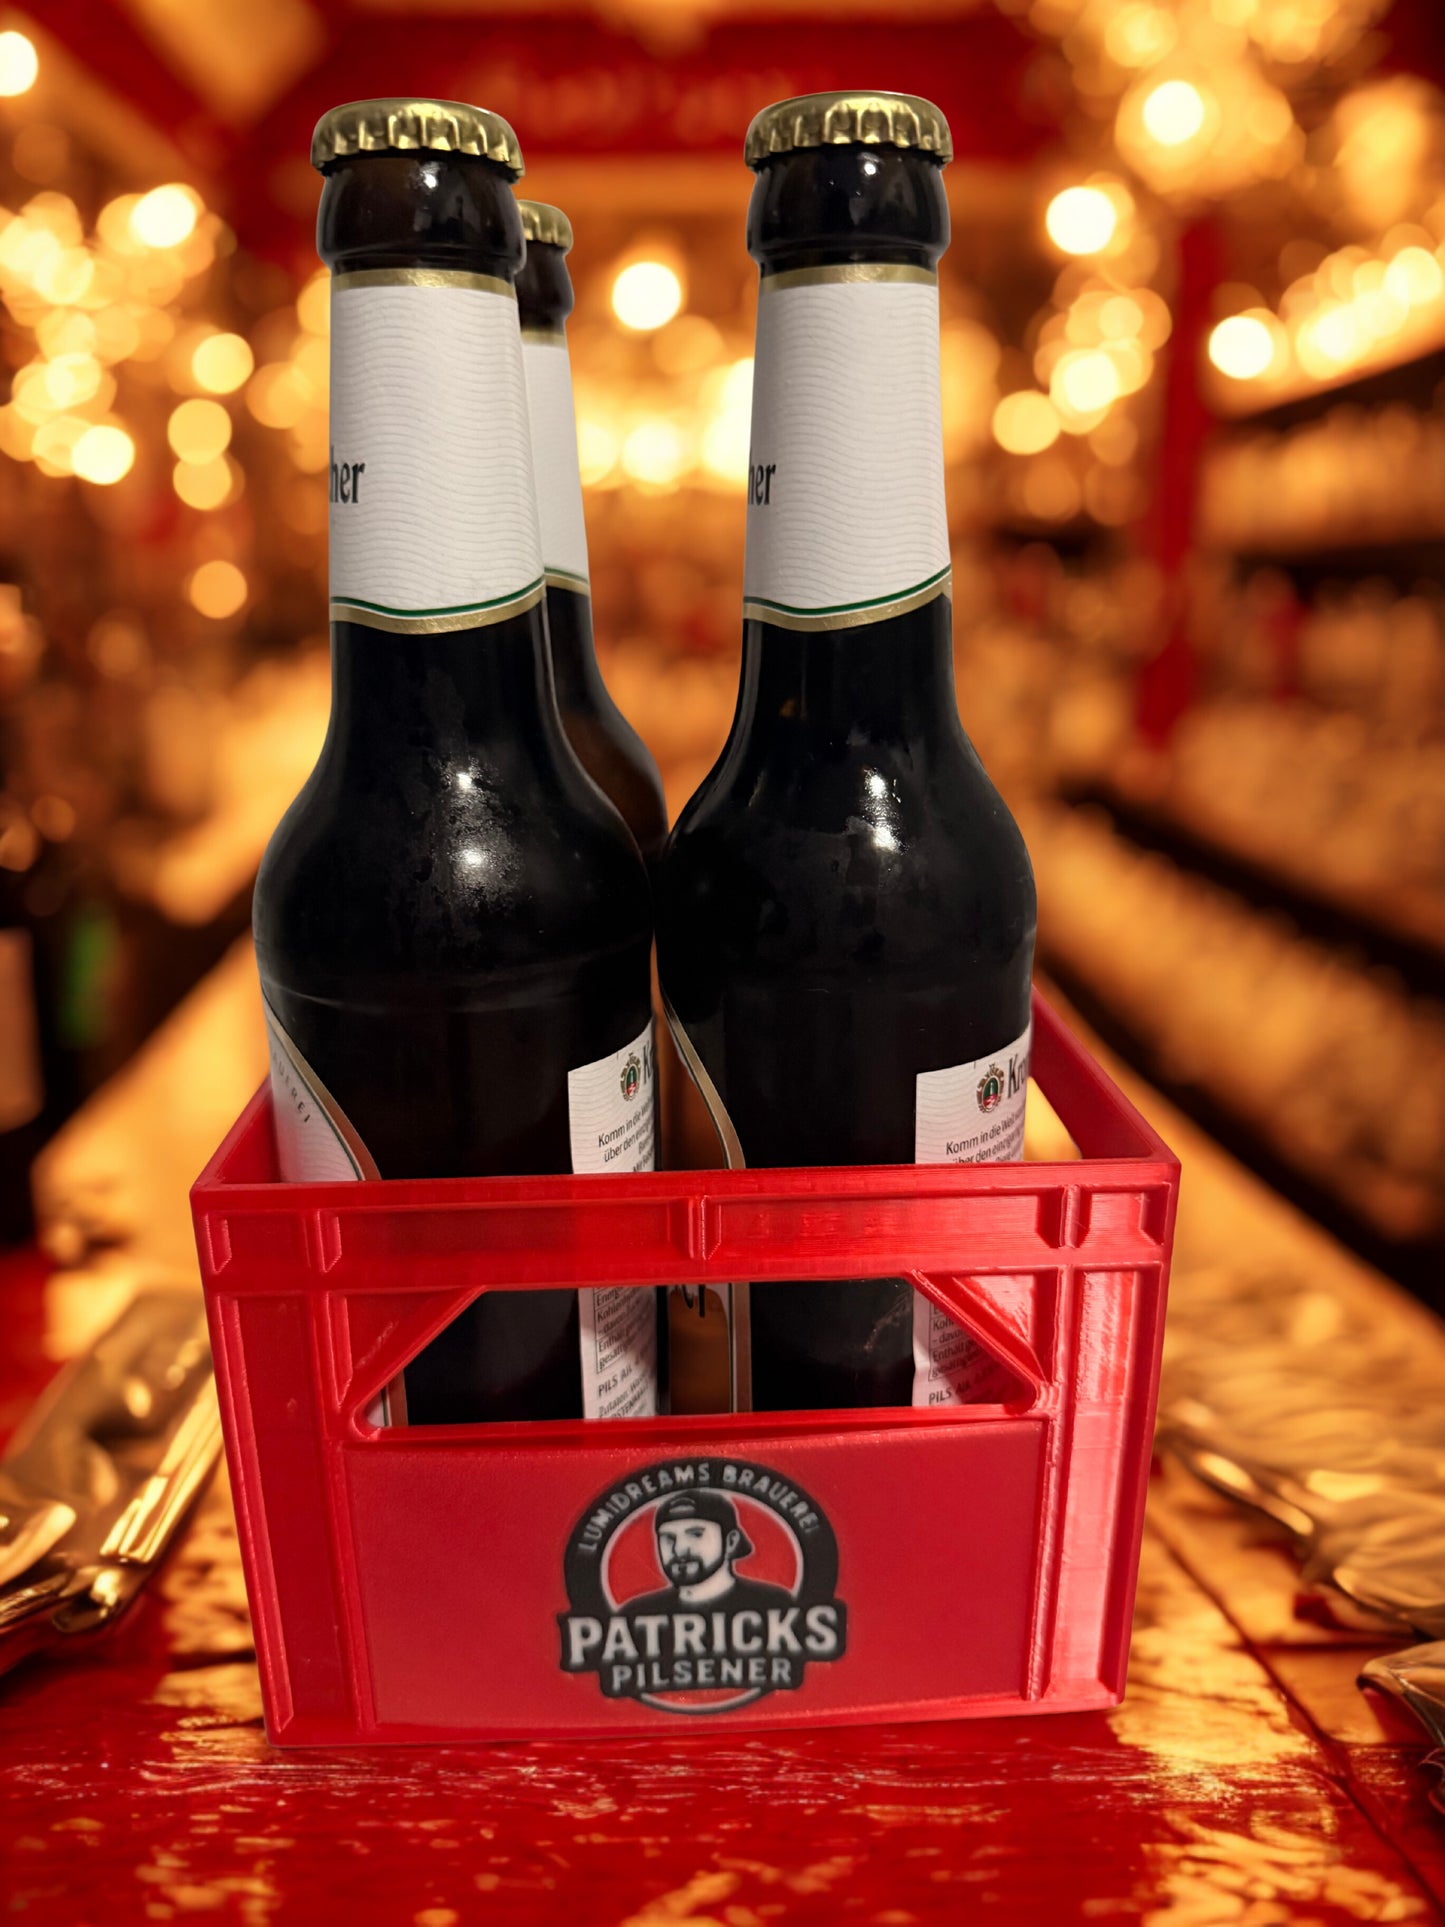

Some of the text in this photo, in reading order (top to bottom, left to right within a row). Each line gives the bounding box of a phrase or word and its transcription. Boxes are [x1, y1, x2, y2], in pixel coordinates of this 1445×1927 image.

[598, 1124, 626, 1148] Komm
[945, 1136, 979, 1156] Komm
[980, 1131, 988, 1144] in
[604, 1143, 623, 1163] über
[598, 1374, 618, 1398] PILS
[929, 1387, 952, 1405] PILS
[577, 1462, 821, 1552] LUMIDREAMS BRAUEREI
[567, 1604, 840, 1666] PATRICKS
[611, 1656, 793, 1692] PILSENER
